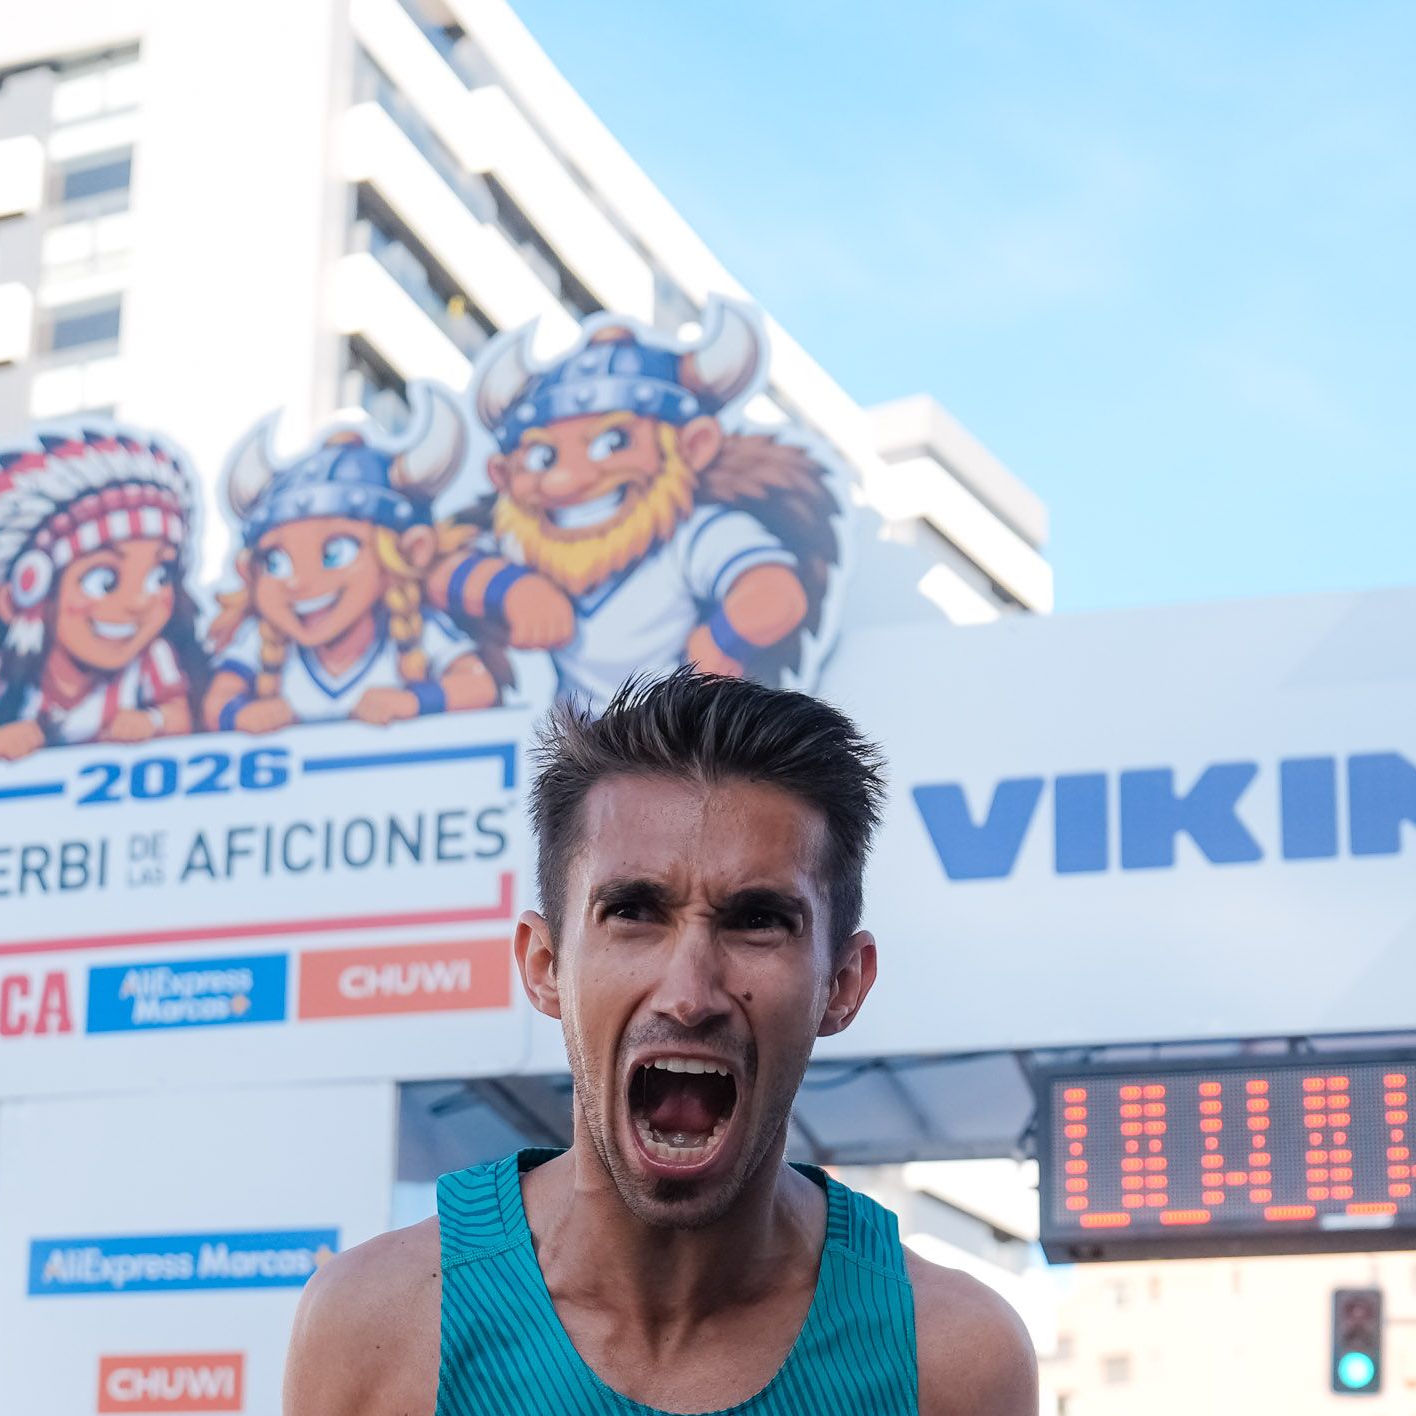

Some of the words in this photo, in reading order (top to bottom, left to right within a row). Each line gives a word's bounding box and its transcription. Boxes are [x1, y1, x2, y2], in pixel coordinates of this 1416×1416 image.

[76, 748, 293, 805] 2026
[128, 831, 168, 861] DE
[180, 806, 510, 884] AFICIONES
[120, 965, 254, 1001] AliExpress
[338, 960, 473, 998] CHUWI
[41, 1246, 194, 1287] AliExpress
[106, 1366, 236, 1401] CHUWI
